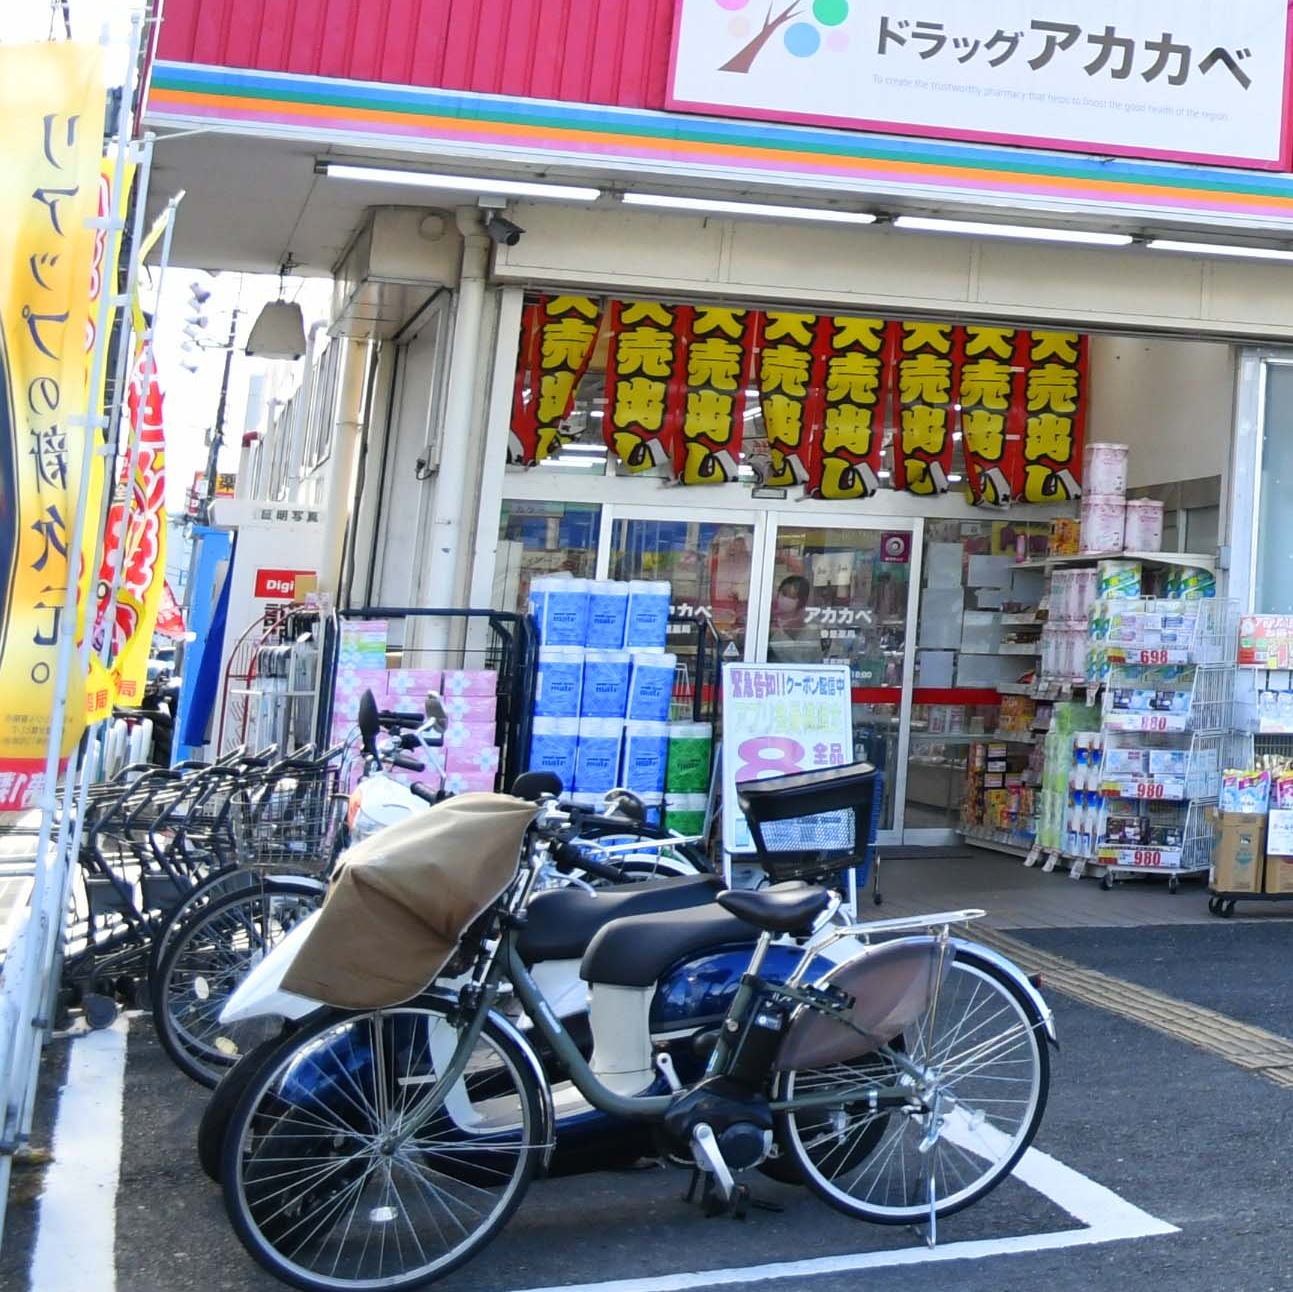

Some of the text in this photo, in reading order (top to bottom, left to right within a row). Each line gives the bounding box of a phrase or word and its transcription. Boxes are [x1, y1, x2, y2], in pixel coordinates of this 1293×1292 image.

[877, 16, 1255, 91] ドラッグアカカベ
[261, 509, 319, 523] 証明写真
[804, 606, 873, 625] アカカベ
[1140, 649, 1169, 664] 698
[1137, 782, 1164, 799] 980
[1133, 851, 1161, 867] 980
